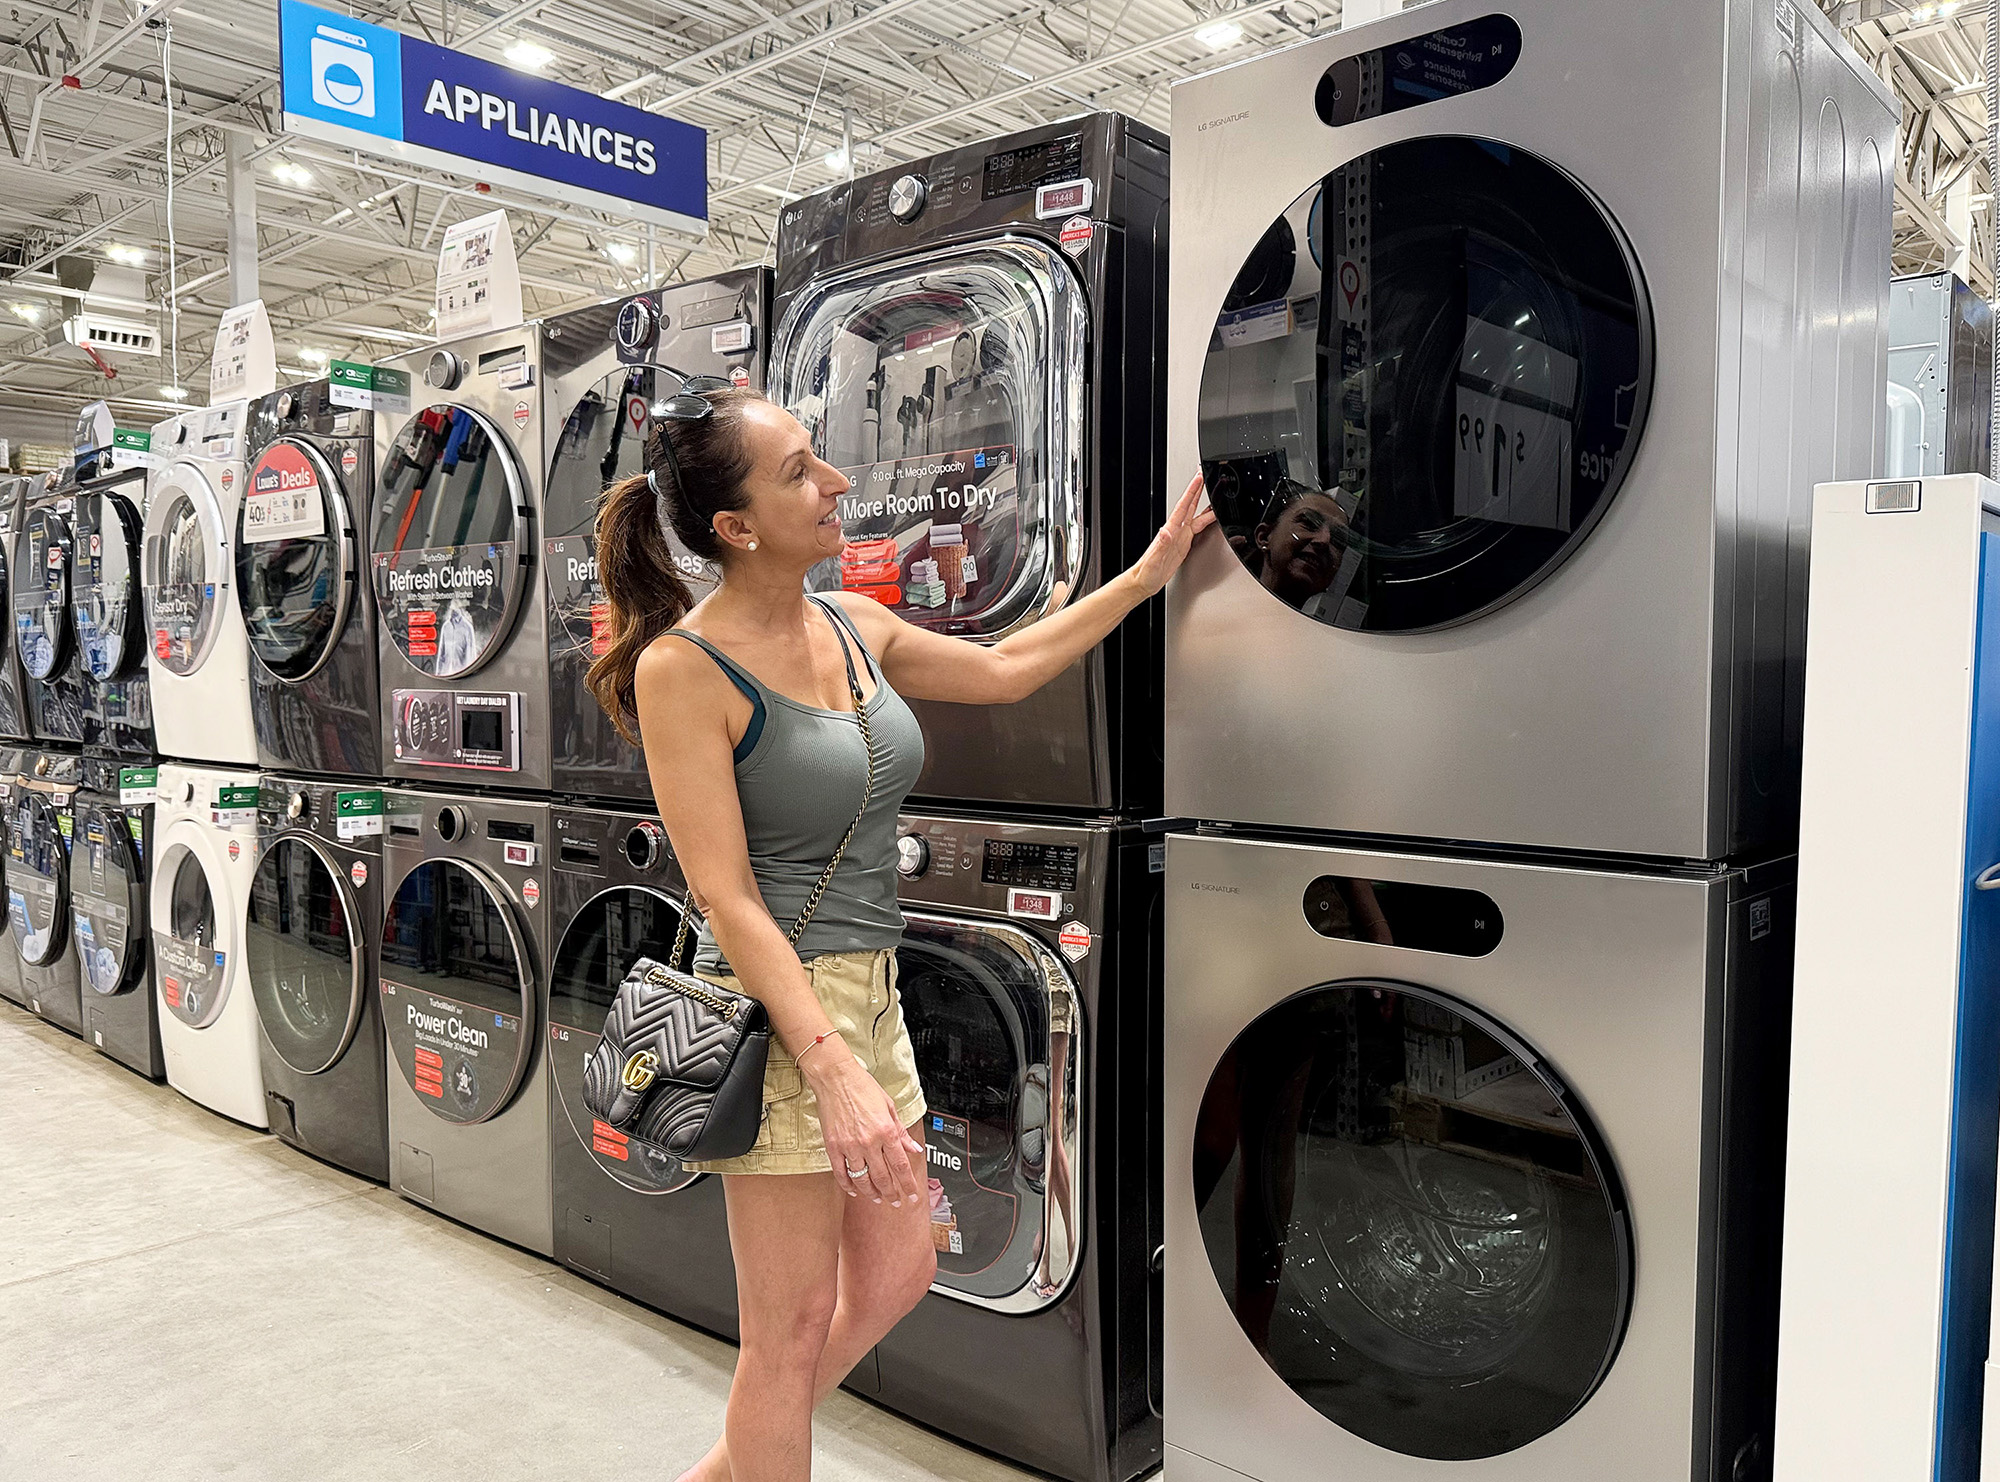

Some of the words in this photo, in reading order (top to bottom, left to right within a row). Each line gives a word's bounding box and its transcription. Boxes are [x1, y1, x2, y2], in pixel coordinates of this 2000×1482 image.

[424, 79, 658, 175] APPLIANCES
[1198, 123, 1207, 132] LG
[1209, 110, 1250, 129] SIGNATURE
[281, 466, 311, 489] Deals
[872, 472, 884, 482] 9.0
[905, 466, 927, 479] Mega
[928, 460, 966, 476] Capacity
[843, 498, 883, 520] More
[886, 493, 934, 516] Room
[936, 487, 960, 510] To
[963, 484, 997, 510] Dry
[555, 542, 564, 553] LG
[379, 557, 387, 567] LG
[962, 562, 975, 572] 9.0
[389, 567, 438, 592] Refresh
[440, 564, 494, 589] Clothes
[1201, 884, 1240, 894] SIGNATURE
[184, 982, 197, 1014] 6
[388, 985, 396, 996] LG
[407, 1004, 445, 1036] Power
[447, 1016, 488, 1049] Clean
[559, 1029, 569, 1041] LG
[925, 1143, 962, 1171] Time
